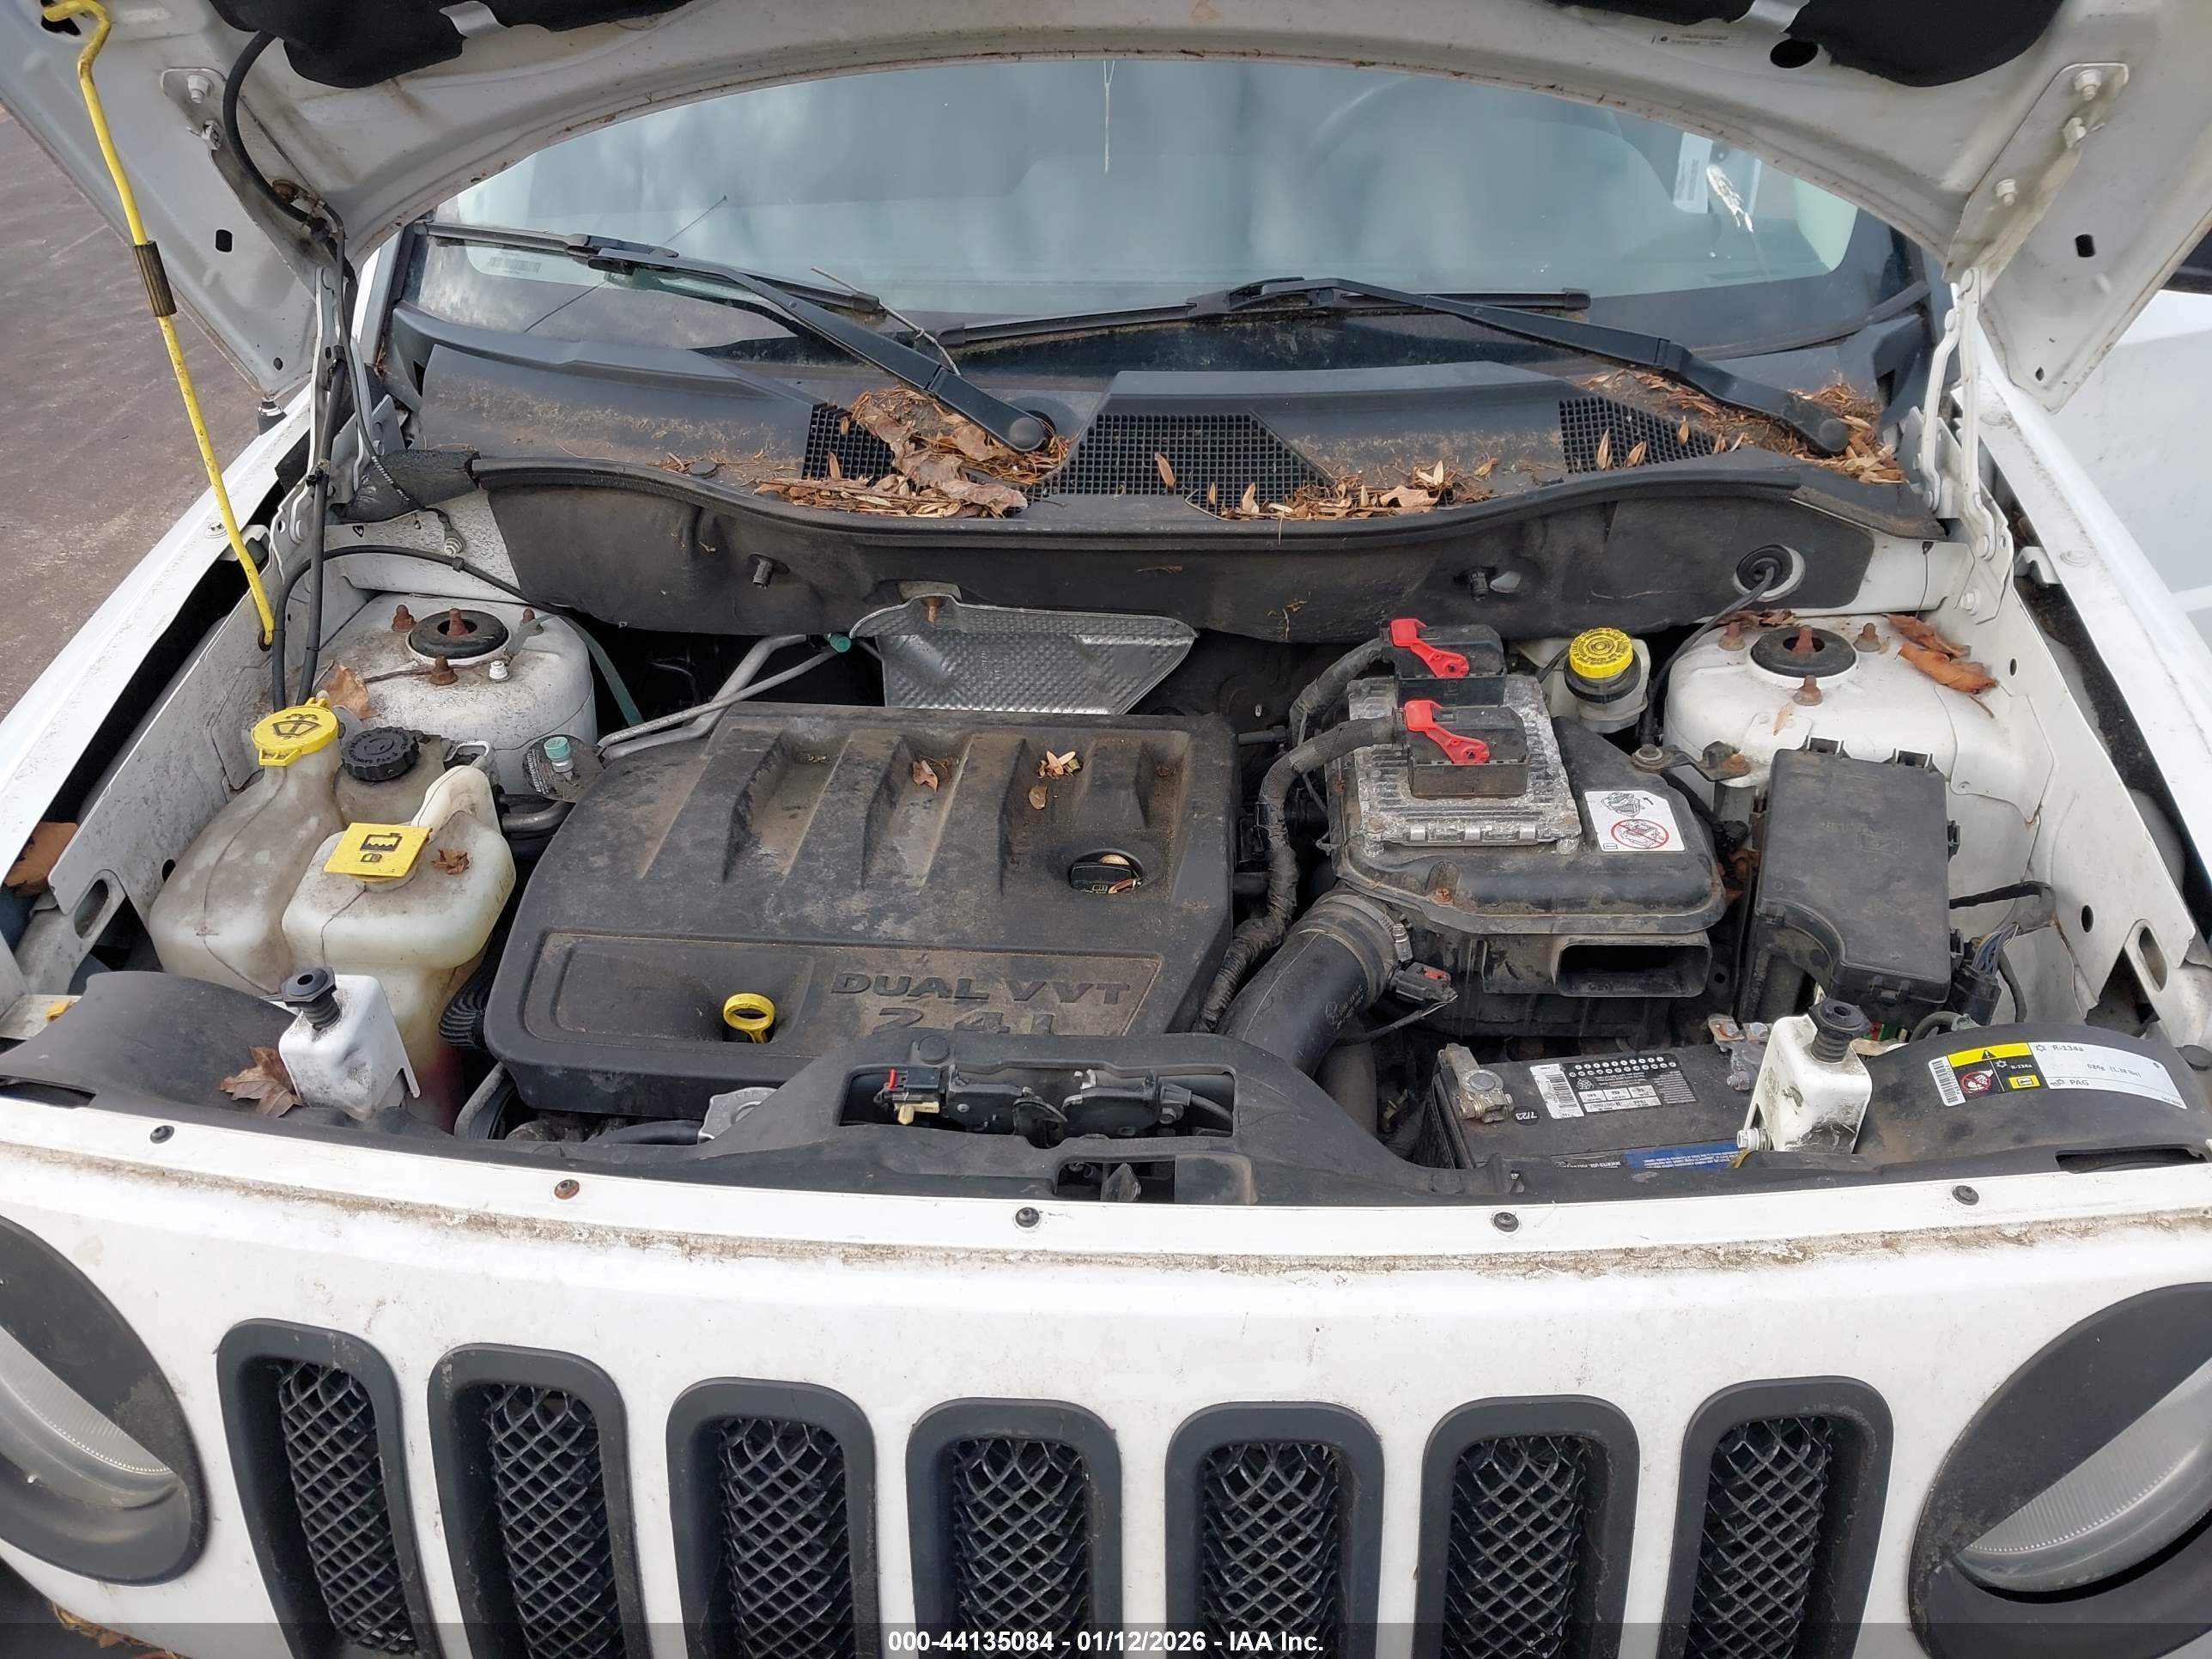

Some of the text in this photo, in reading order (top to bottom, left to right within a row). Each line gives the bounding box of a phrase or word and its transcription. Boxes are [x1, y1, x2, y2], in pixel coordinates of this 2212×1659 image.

[830, 972, 1130, 1005] DUAL VVT
[872, 1006, 1055, 1036] 24L
